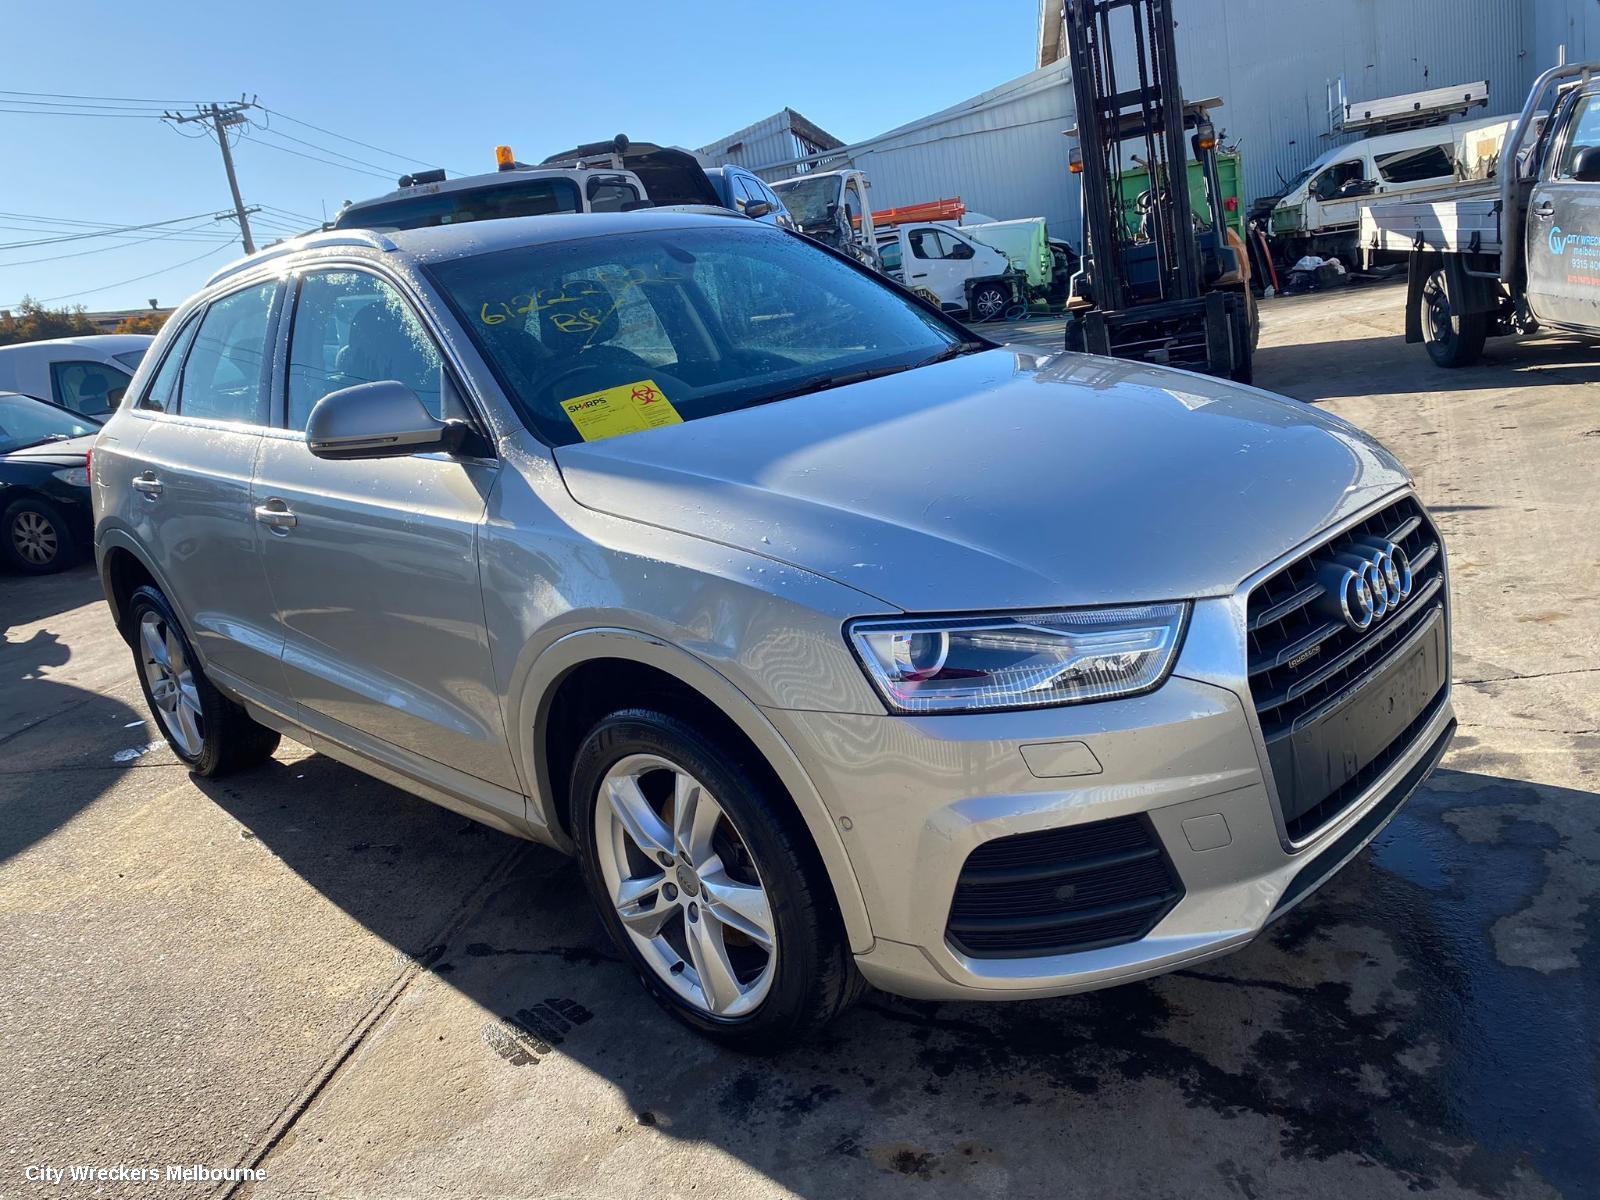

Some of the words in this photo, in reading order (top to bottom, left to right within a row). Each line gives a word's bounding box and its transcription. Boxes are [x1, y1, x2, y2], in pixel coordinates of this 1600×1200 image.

[1567, 234, 1580, 245] CITY
[1581, 235, 1600, 247] WREC
[1572, 258, 1587, 269] 9315
[567, 397, 607, 413] SHARPS
[1290, 645, 1320, 667] quattro
